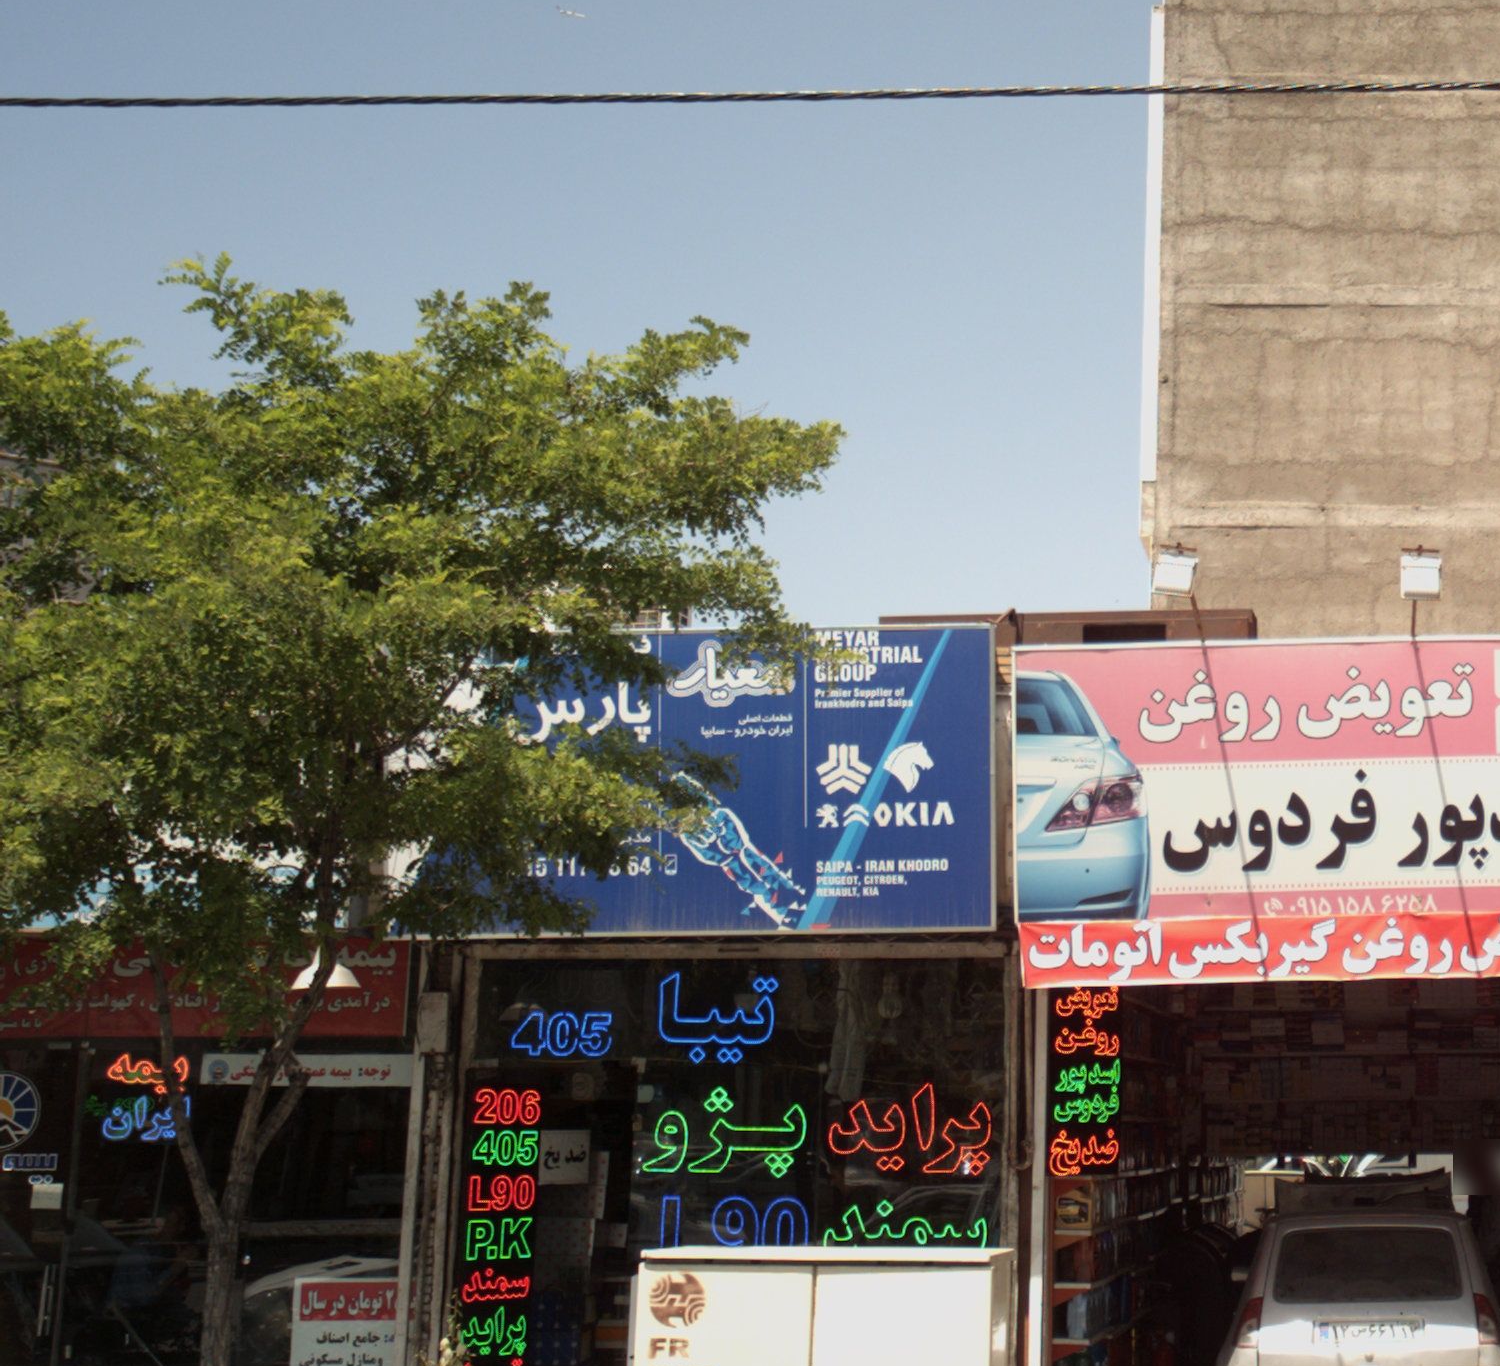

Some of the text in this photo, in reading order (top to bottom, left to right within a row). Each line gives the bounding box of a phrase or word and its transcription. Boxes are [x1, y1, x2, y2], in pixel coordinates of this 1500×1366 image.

[816, 646, 922, 664] USTRIAL
[1138, 663, 1474, 743] تعویض روغن
[701, 725, 794, 740] ایران خودرو سایپا
[895, 801, 955, 827] KIA
[1163, 768, 1378, 872] فردوس
[816, 859, 949, 873] SAIPA IRAN KHODRO
[1342, 919, 1453, 977] روغن
[659, 972, 778, 1063] تیبا
[1055, 986, 1119, 1018] تعویض
[511, 1010, 613, 1057] 405
[1055, 1019, 1120, 1057] روغن
[474, 1088, 541, 1125] 206
[1053, 1087, 1120, 1123] فردوس
[643, 1086, 806, 1178] پژو
[828, 1083, 992, 1174] پراید
[472, 1130, 538, 1166] 405
[467, 1175, 536, 1212] L90
[466, 1218, 533, 1261] P.K
[302, 1290, 328, 1316] سال
[348, 1290, 383, 1315] تومان
[462, 1268, 530, 1303] سمند
[329, 1293, 346, 1316] در
[316, 1332, 350, 1344] اصناف
[352, 1332, 380, 1348] جامع
[461, 1306, 527, 1356] پراید
[648, 1337, 689, 1360] FR
